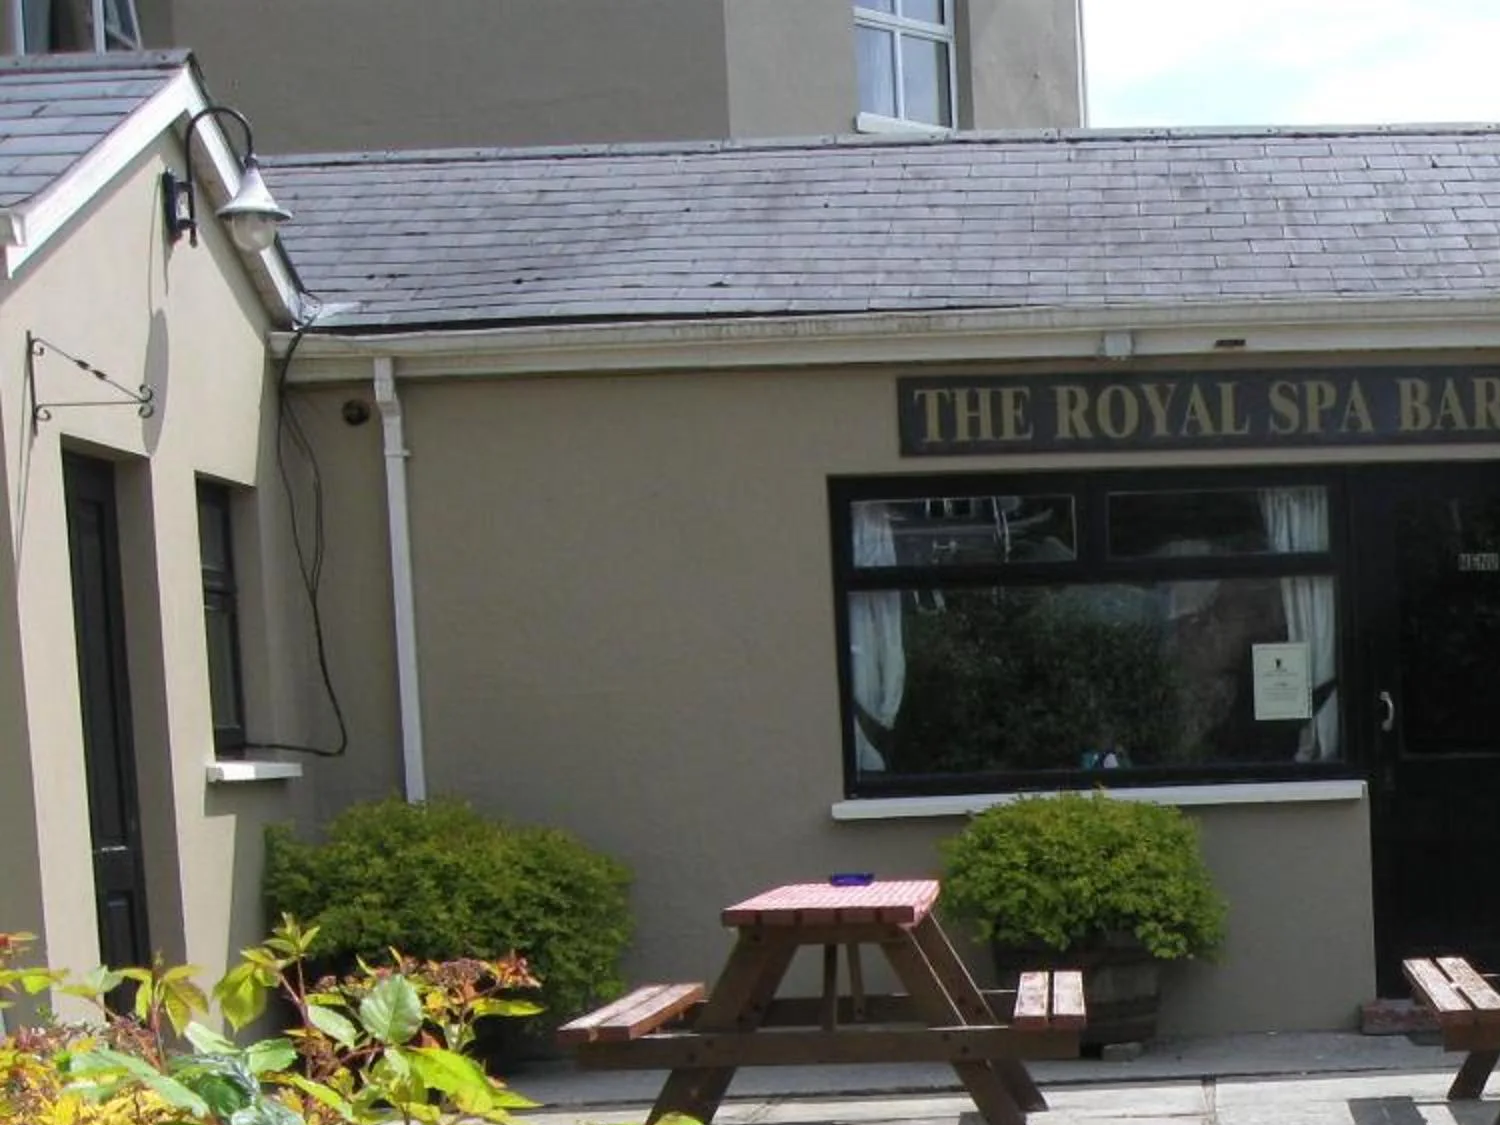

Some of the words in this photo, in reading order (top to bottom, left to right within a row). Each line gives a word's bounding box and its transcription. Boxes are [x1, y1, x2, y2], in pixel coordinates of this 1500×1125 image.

[914, 386, 1033, 443] THE
[1055, 381, 1250, 439] ROYAL
[1269, 380, 1376, 435] SPA
